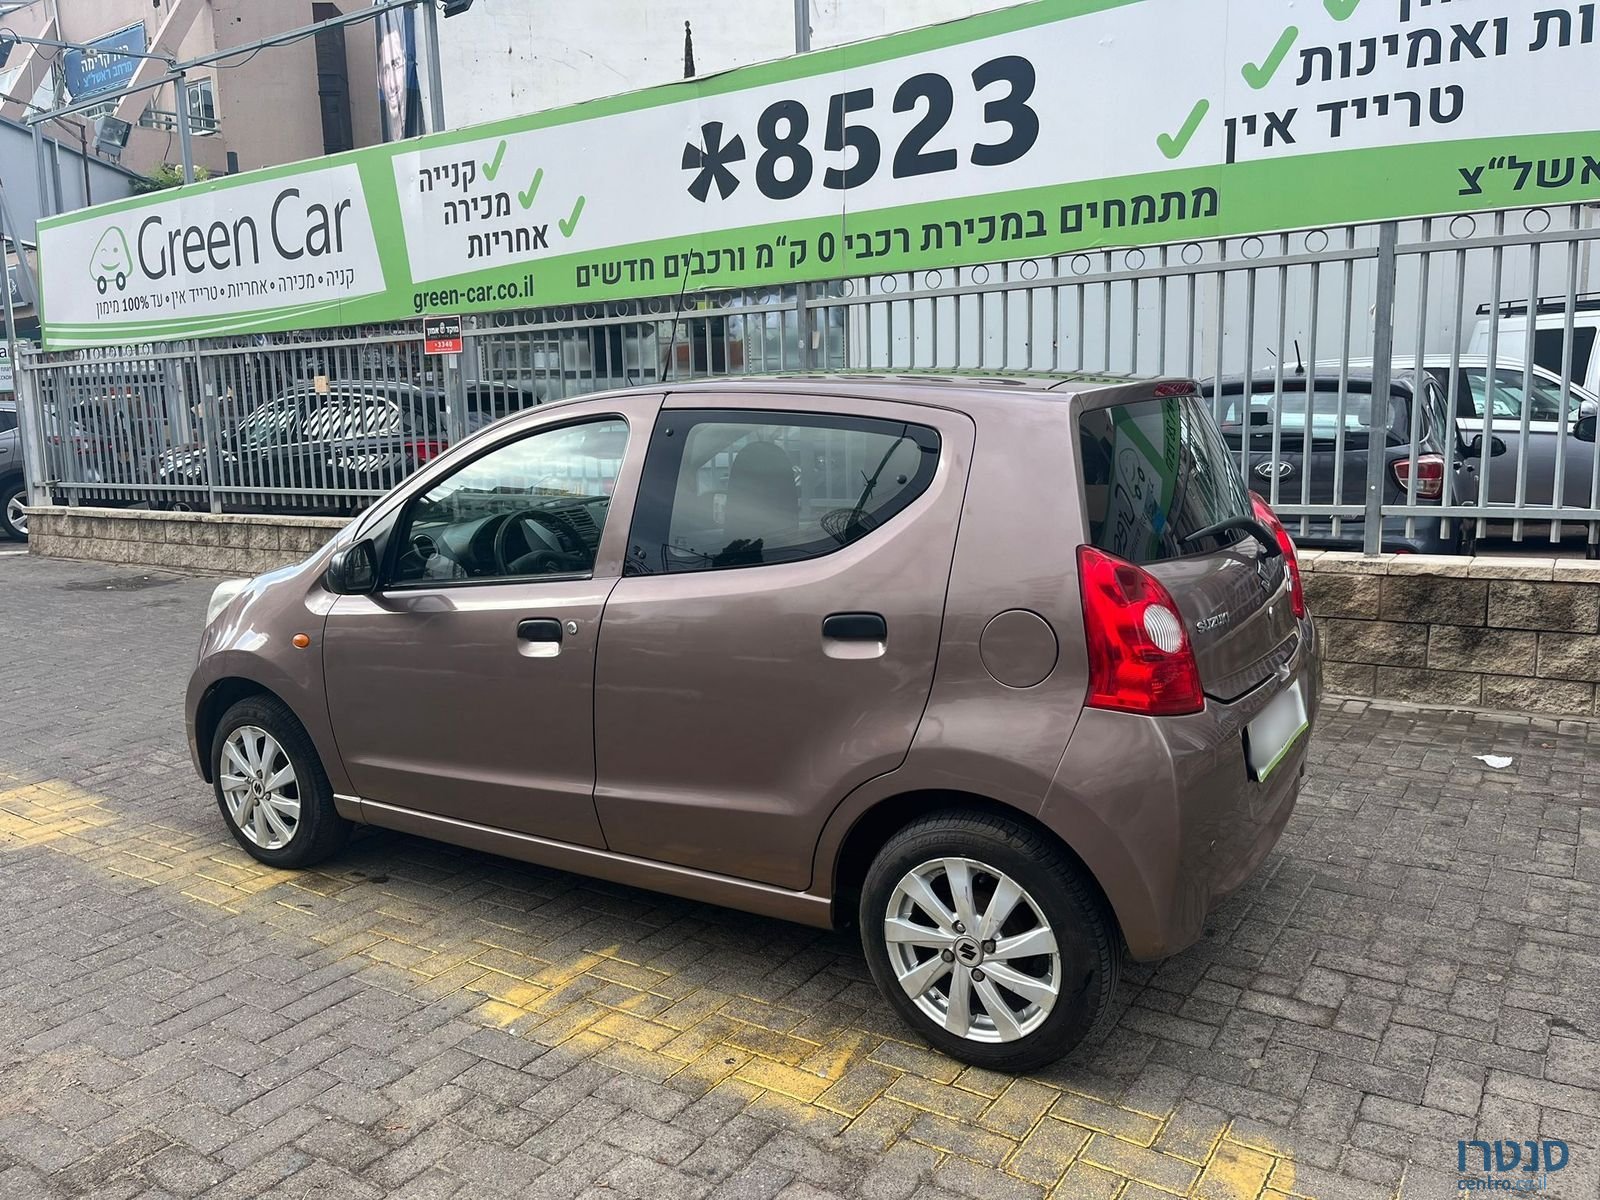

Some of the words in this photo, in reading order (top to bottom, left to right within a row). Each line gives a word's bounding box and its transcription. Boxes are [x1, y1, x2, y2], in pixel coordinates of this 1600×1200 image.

[80, 53, 110, 73] קדימה
[1295, 16, 1508, 87] ואמינות
[112, 62, 132, 76] מרחב
[1316, 84, 1464, 138] טרייד
[1224, 107, 1298, 165] אין
[419, 159, 476, 193] קנייה
[443, 191, 511, 225] מכירה
[1060, 186, 1218, 234] מתמחים
[137, 215, 260, 281] Green
[270, 188, 352, 261] Car
[467, 223, 549, 259] אחריות
[844, 227, 910, 259] רכבי
[920, 209, 1047, 251] במכירת
[664, 246, 745, 279] ורכבים
[817, 232, 836, 263] 0
[278, 273, 315, 293] מכירה
[326, 268, 355, 290] קניה
[576, 257, 655, 288] חדשים
[122, 295, 150, 312] 100%
[150, 292, 163, 309] עד
[171, 289, 187, 310] אין
[188, 285, 218, 302] טרייד
[227, 279, 268, 300] אחריות
[413, 274, 534, 314] green-car.co.il
[96, 299, 120, 320] מימון
[1196, 611, 1230, 633] SUZUKI
